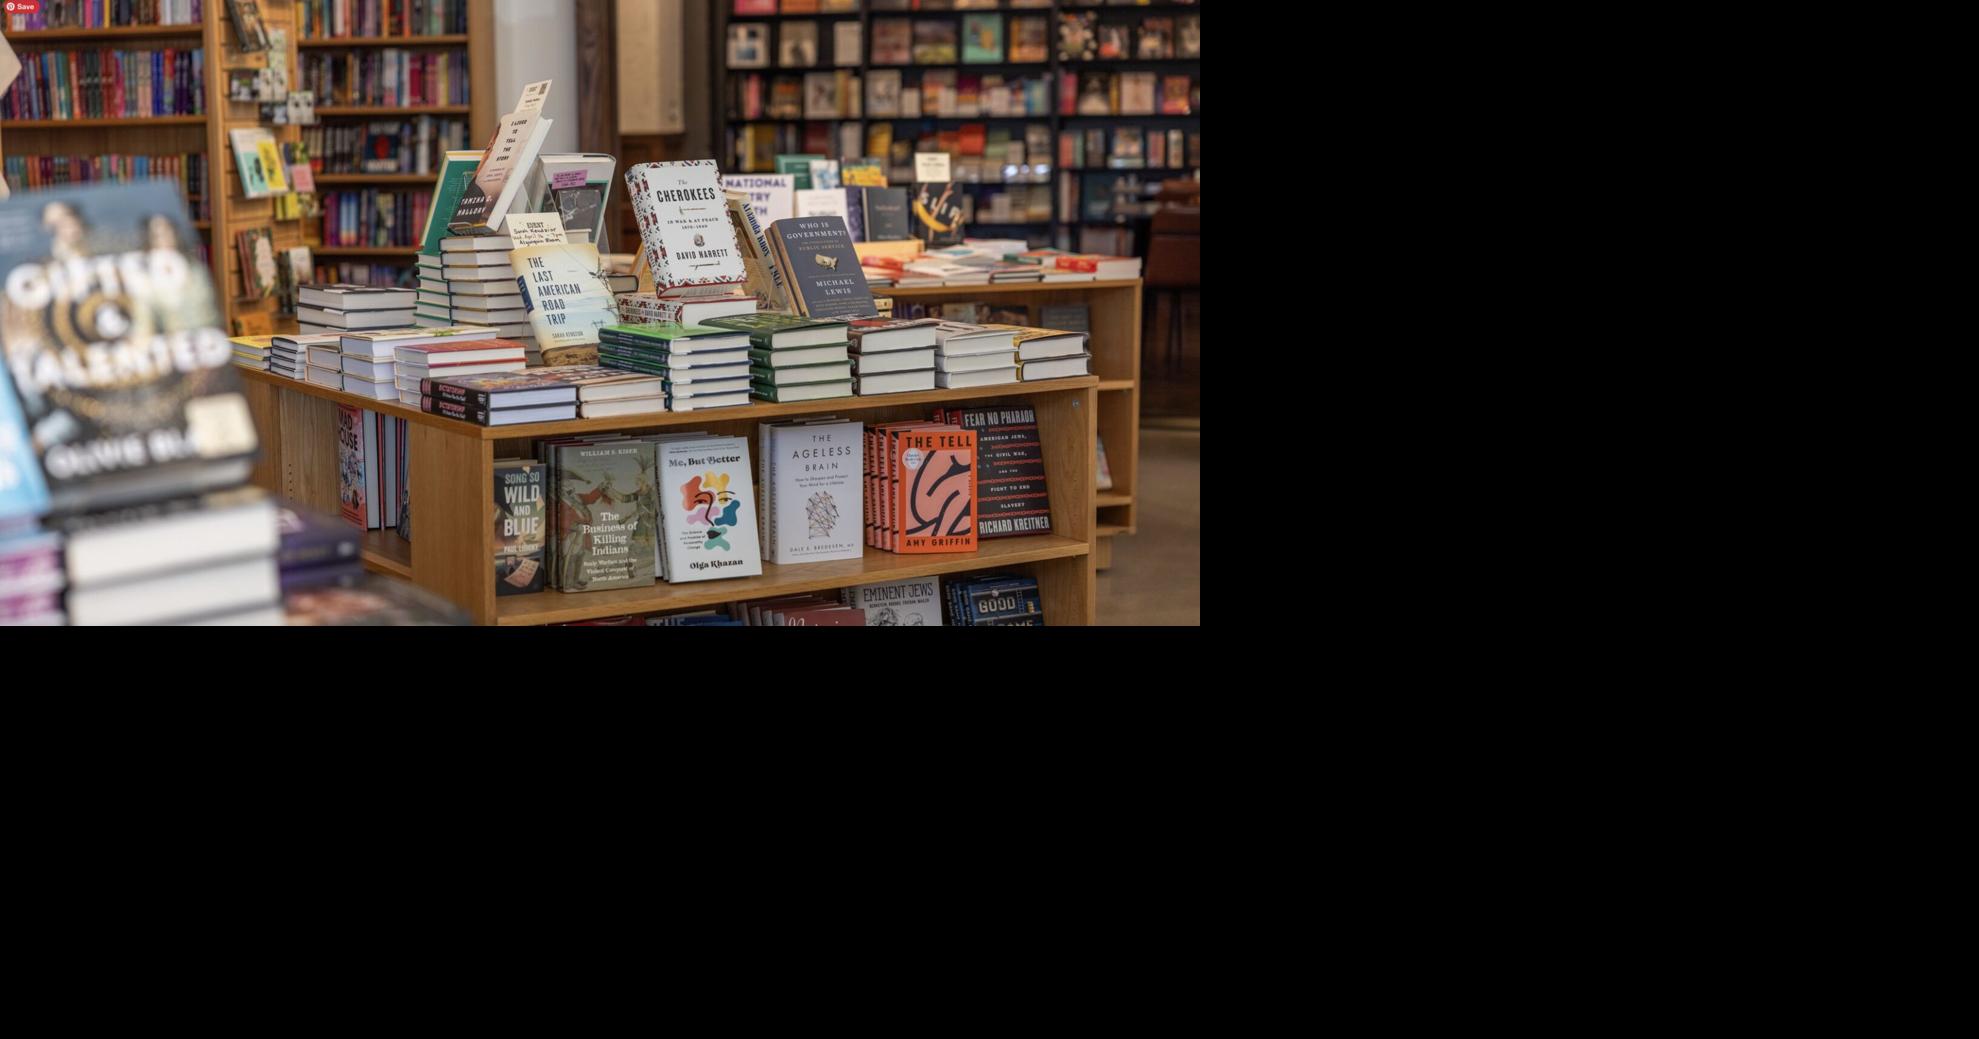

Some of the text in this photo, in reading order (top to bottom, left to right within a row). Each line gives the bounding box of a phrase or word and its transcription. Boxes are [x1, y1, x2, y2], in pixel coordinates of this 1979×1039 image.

[726, 178, 786, 188] NATIONAL
[656, 187, 716, 202] CHEROKEES
[456, 206, 487, 216] MALLORY
[786, 230, 847, 240] GOVERNMENT?
[676, 250, 697, 260] DAVID
[528, 257, 544, 268] THE
[532, 270, 554, 282] LAST
[816, 279, 855, 287] MICHAEL
[538, 284, 582, 297] AMERICAN
[825, 288, 852, 296] LEWIS
[542, 299, 566, 312] ROAD
[546, 313, 566, 326] TRIP
[964, 410, 1035, 427] FEAR NO PHARAOH
[906, 435, 972, 448] THE TELL
[792, 446, 851, 460] AGELESS
[668, 456, 740, 468] Me, But Better
[806, 462, 838, 472] BRAIN
[504, 472, 540, 484] SONG SO
[504, 485, 540, 504] WILD
[514, 505, 530, 516] AND
[600, 512, 620, 522] The
[504, 517, 538, 536] BLUE
[582, 520, 639, 534] Business of
[979, 516, 1050, 534] RICHARD KREITNER
[593, 534, 628, 545] Killing
[931, 538, 971, 546] GRIFFIN
[592, 545, 629, 556] Indians
[690, 559, 744, 570] Olga Khazan
[863, 585, 906, 602] EMINENT
[908, 582, 934, 598] JEWS
[978, 597, 1016, 613] GOOD
